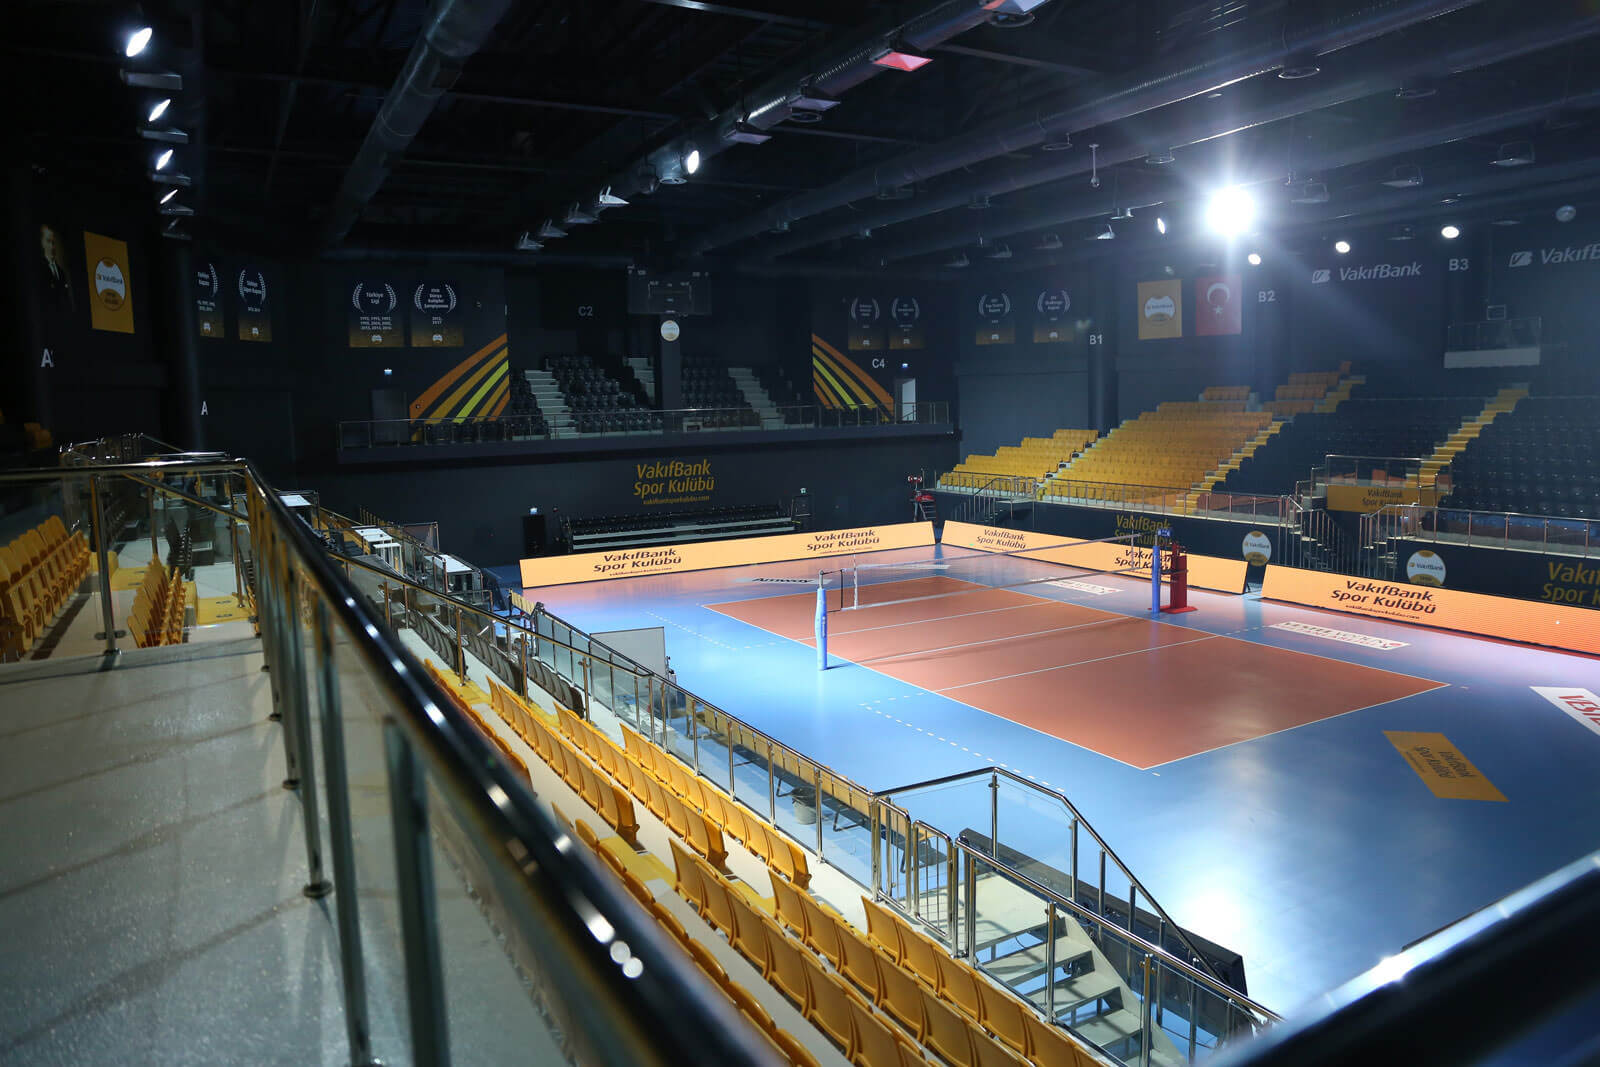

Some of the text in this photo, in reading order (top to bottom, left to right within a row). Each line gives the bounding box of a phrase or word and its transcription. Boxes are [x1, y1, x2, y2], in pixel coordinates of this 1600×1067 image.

[1339, 262, 1422, 281] VakıfBank
[1448, 258, 1470, 272] B3
[1258, 290, 1276, 303] B2
[578, 305, 593, 317] C2
[1089, 333, 1103, 345] B1
[40, 347, 55, 368] A
[872, 358, 886, 369] C4
[201, 400, 208, 415] A
[636, 458, 711, 480] VakıfBank
[633, 477, 715, 500] Spor Kulübü
[815, 530, 876, 542] VakıfBank
[976, 535, 994, 544] Spor
[984, 529, 1025, 541] VakıfBank
[807, 543, 835, 552] Spor
[604, 548, 676, 562] VakıfBank
[593, 557, 682, 573] Spor Kulübü
[1346, 580, 1433, 602] VakıfBank
[1331, 590, 1437, 615] Spor Kulübü
